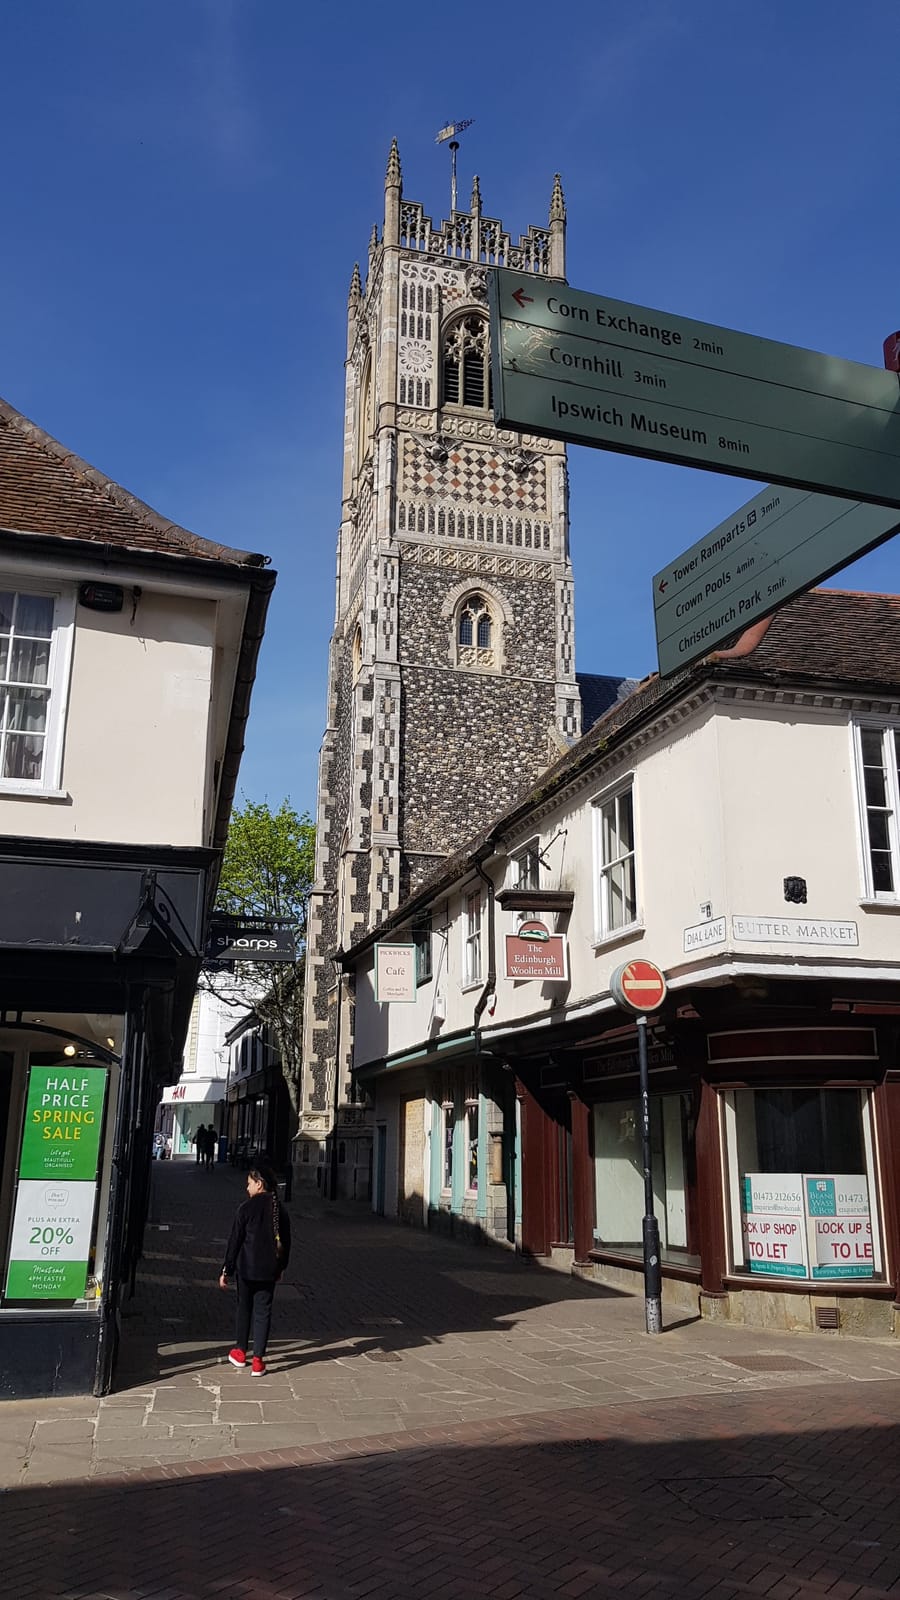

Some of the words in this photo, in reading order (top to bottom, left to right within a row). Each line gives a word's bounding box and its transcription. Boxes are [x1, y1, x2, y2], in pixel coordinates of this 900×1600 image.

[546, 297, 589, 322] Corn
[597, 310, 682, 345] Exchange
[693, 338, 724, 356] 2min
[550, 346, 623, 378] Cornhill
[633, 370, 667, 389] 3min
[551, 395, 623, 427] Ipswich
[630, 415, 707, 445] Museum
[718, 436, 750, 454] 8min
[672, 558, 699, 583] Tower
[700, 520, 746, 564] Ramparts
[760, 496, 781, 518] 3min
[675, 591, 703, 618] Crown
[705, 570, 732, 598] Pools
[736, 556, 755, 575] 4min
[678, 608, 736, 653] Christchurch
[738, 590, 763, 615] Park
[687, 931, 703, 945] DIAL
[704, 924, 723, 940] LANE
[737, 921, 792, 937] BUTTER
[797, 924, 854, 940] MARKET
[216, 935, 278, 950] sharps
[527, 944, 543, 953] The
[514, 954, 557, 965] Edinburgh
[385, 966, 406, 976] Café
[510, 966, 543, 976] Woollen
[544, 966, 562, 976] Mill
[46, 1077, 89, 1091] HALF
[41, 1094, 89, 1108] PRICE
[32, 1109, 95, 1124] SPRING
[42, 1126, 82, 1140] SALE
[753, 1191, 774, 1201] 01473
[774, 1192, 801, 1202] 212656
[838, 1193, 864, 1203] 01473
[743, 1222, 758, 1233] OCK
[760, 1223, 771, 1234] UP
[773, 1223, 797, 1235] SHOP
[817, 1222, 845, 1234] LOCK
[848, 1222, 862, 1234] UP
[29, 1227, 74, 1245] 20%
[41, 1246, 61, 1256] OFF
[749, 1241, 764, 1257] TO
[766, 1243, 788, 1259] LET
[831, 1242, 851, 1259] TO
[855, 1243, 873, 1258] LE
